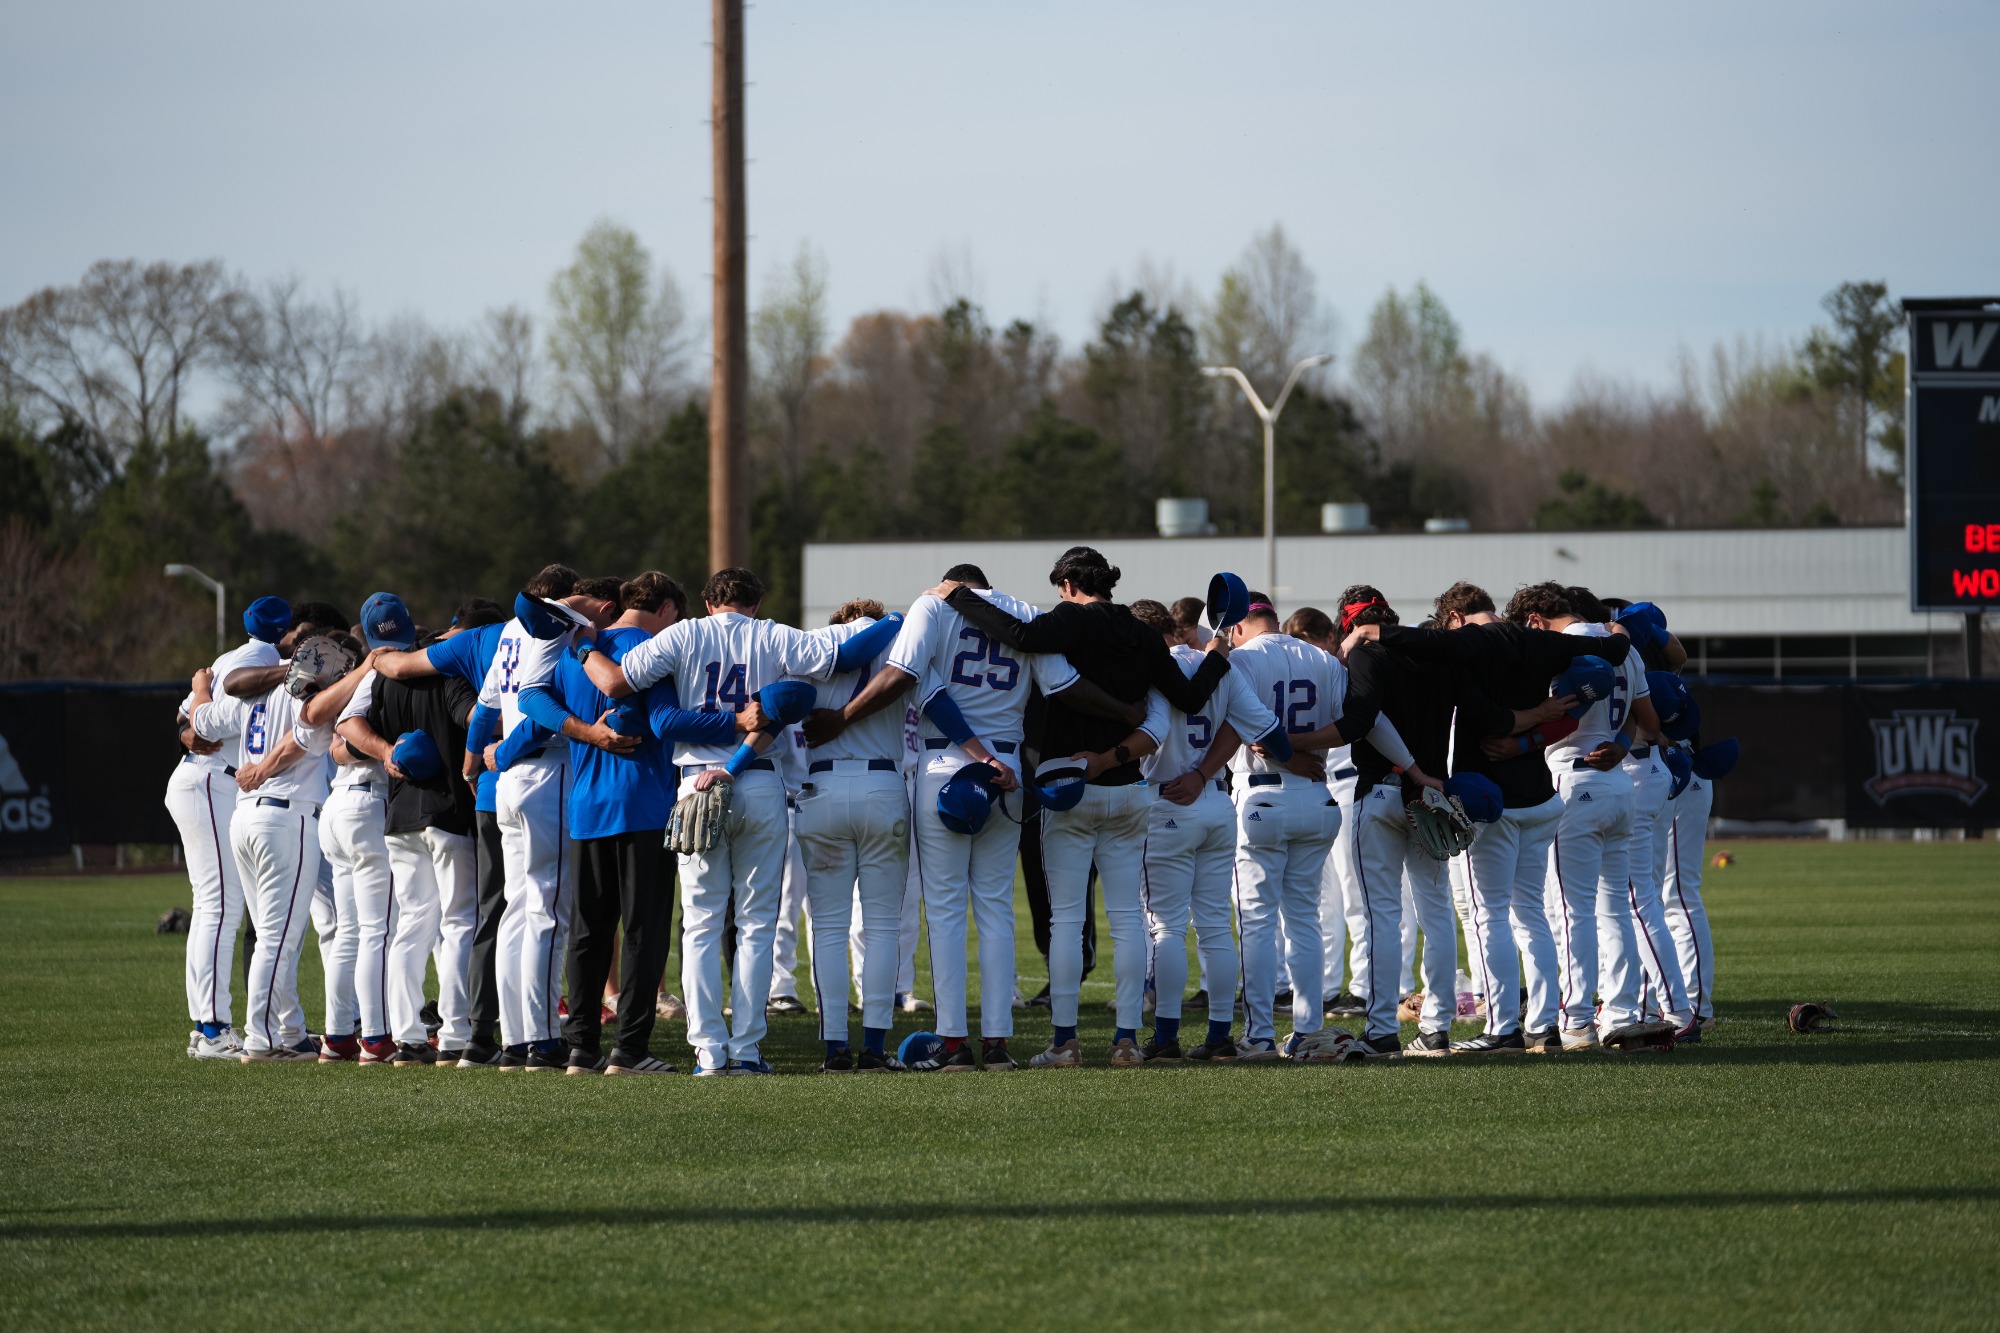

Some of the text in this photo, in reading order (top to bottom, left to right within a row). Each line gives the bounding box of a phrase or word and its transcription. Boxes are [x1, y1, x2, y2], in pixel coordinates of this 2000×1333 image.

[1932, 321, 2000, 368] W
[1965, 523, 2000, 552] BE
[1952, 568, 2000, 598] WO
[377, 620, 397, 633] UWG
[951, 626, 1020, 692] 25
[701, 660, 749, 714] 14
[1273, 678, 1317, 735] 12
[1609, 675, 1628, 731] 6
[1186, 713, 1212, 750] 5
[1879, 715, 1970, 778] UWG
